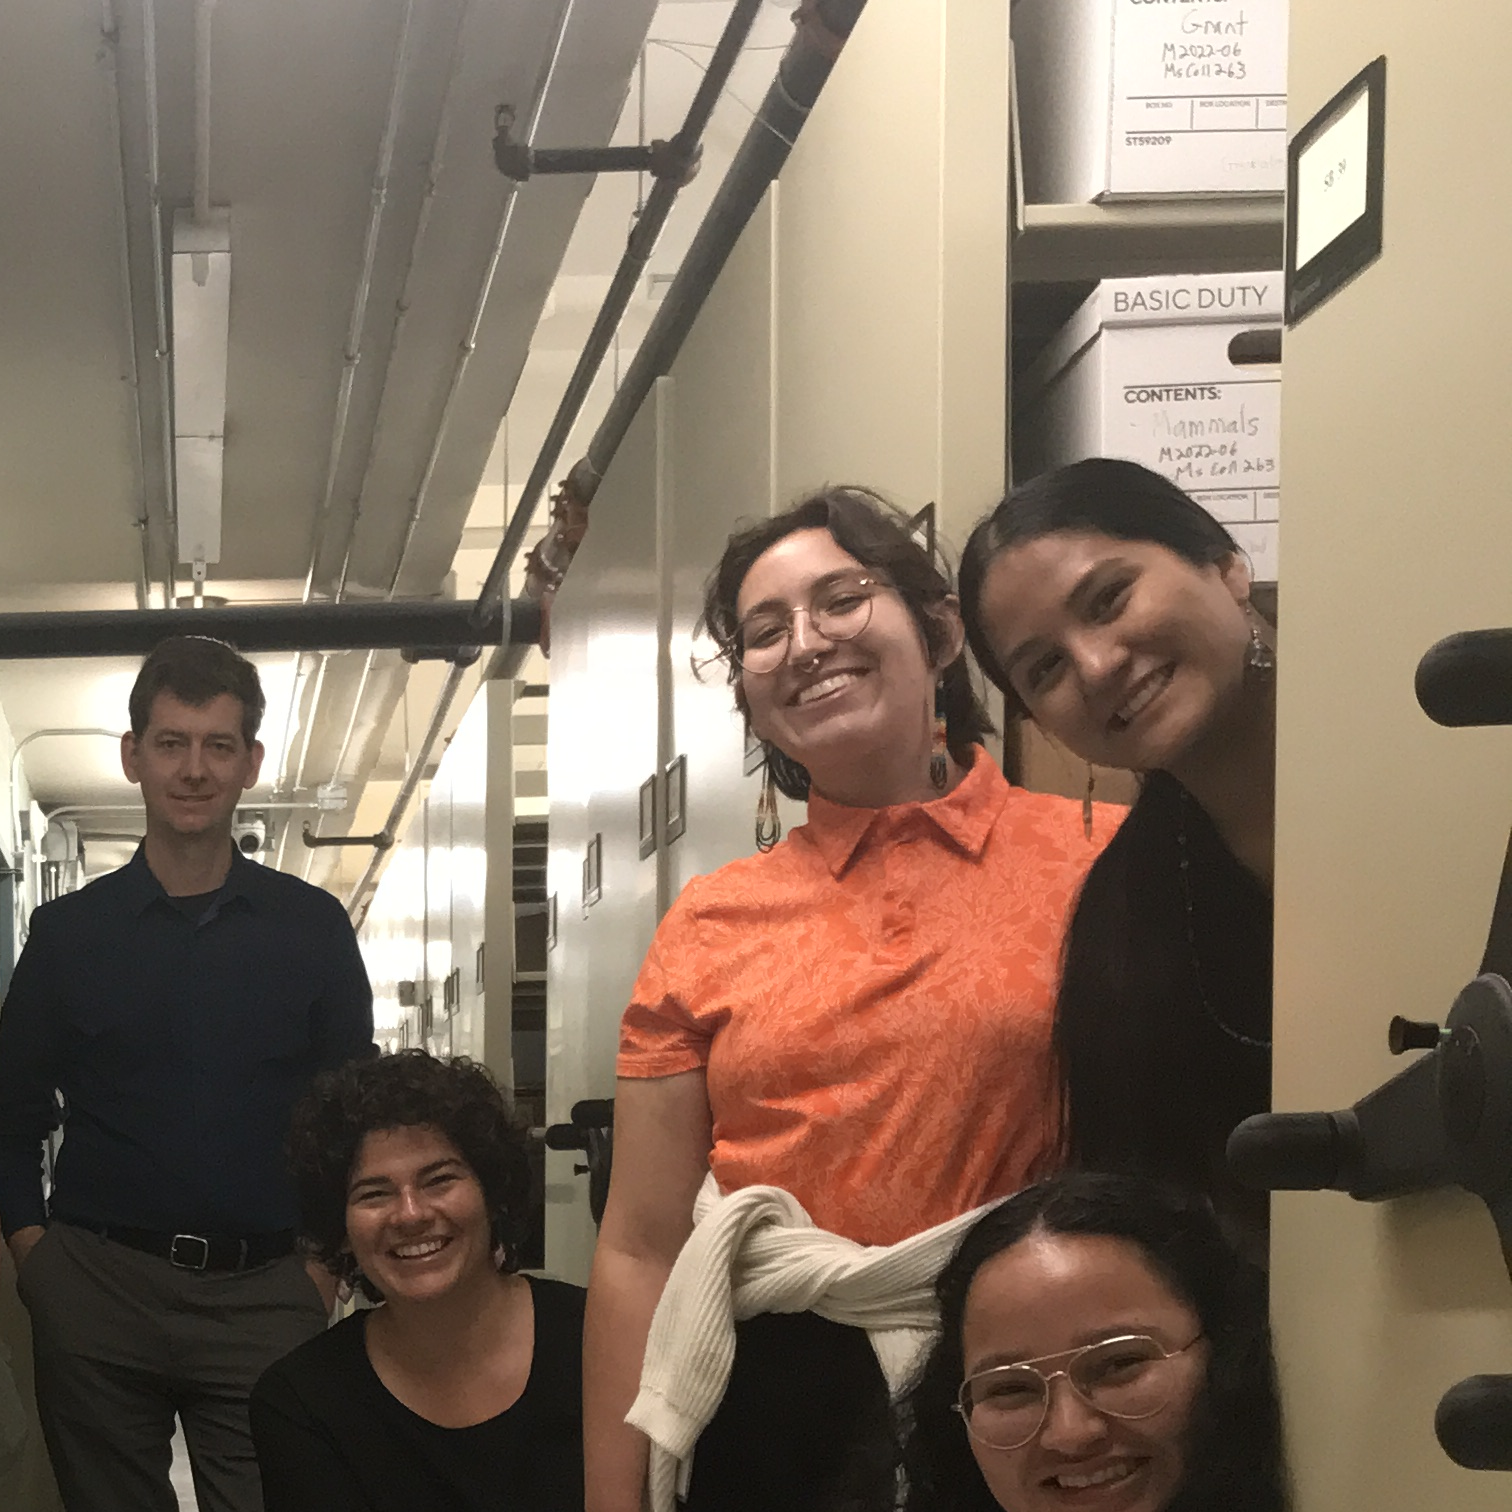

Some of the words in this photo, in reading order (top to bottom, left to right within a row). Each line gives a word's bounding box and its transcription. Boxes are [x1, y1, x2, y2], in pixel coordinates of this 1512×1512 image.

[1214, 61, 1246, 79] 263
[1114, 288, 1190, 312] BASIC
[1198, 285, 1268, 309] DUTY
[1124, 387, 1222, 404] CONTENTS:
[1153, 403, 1259, 439] Mammals
[1243, 457, 1275, 473] 263
